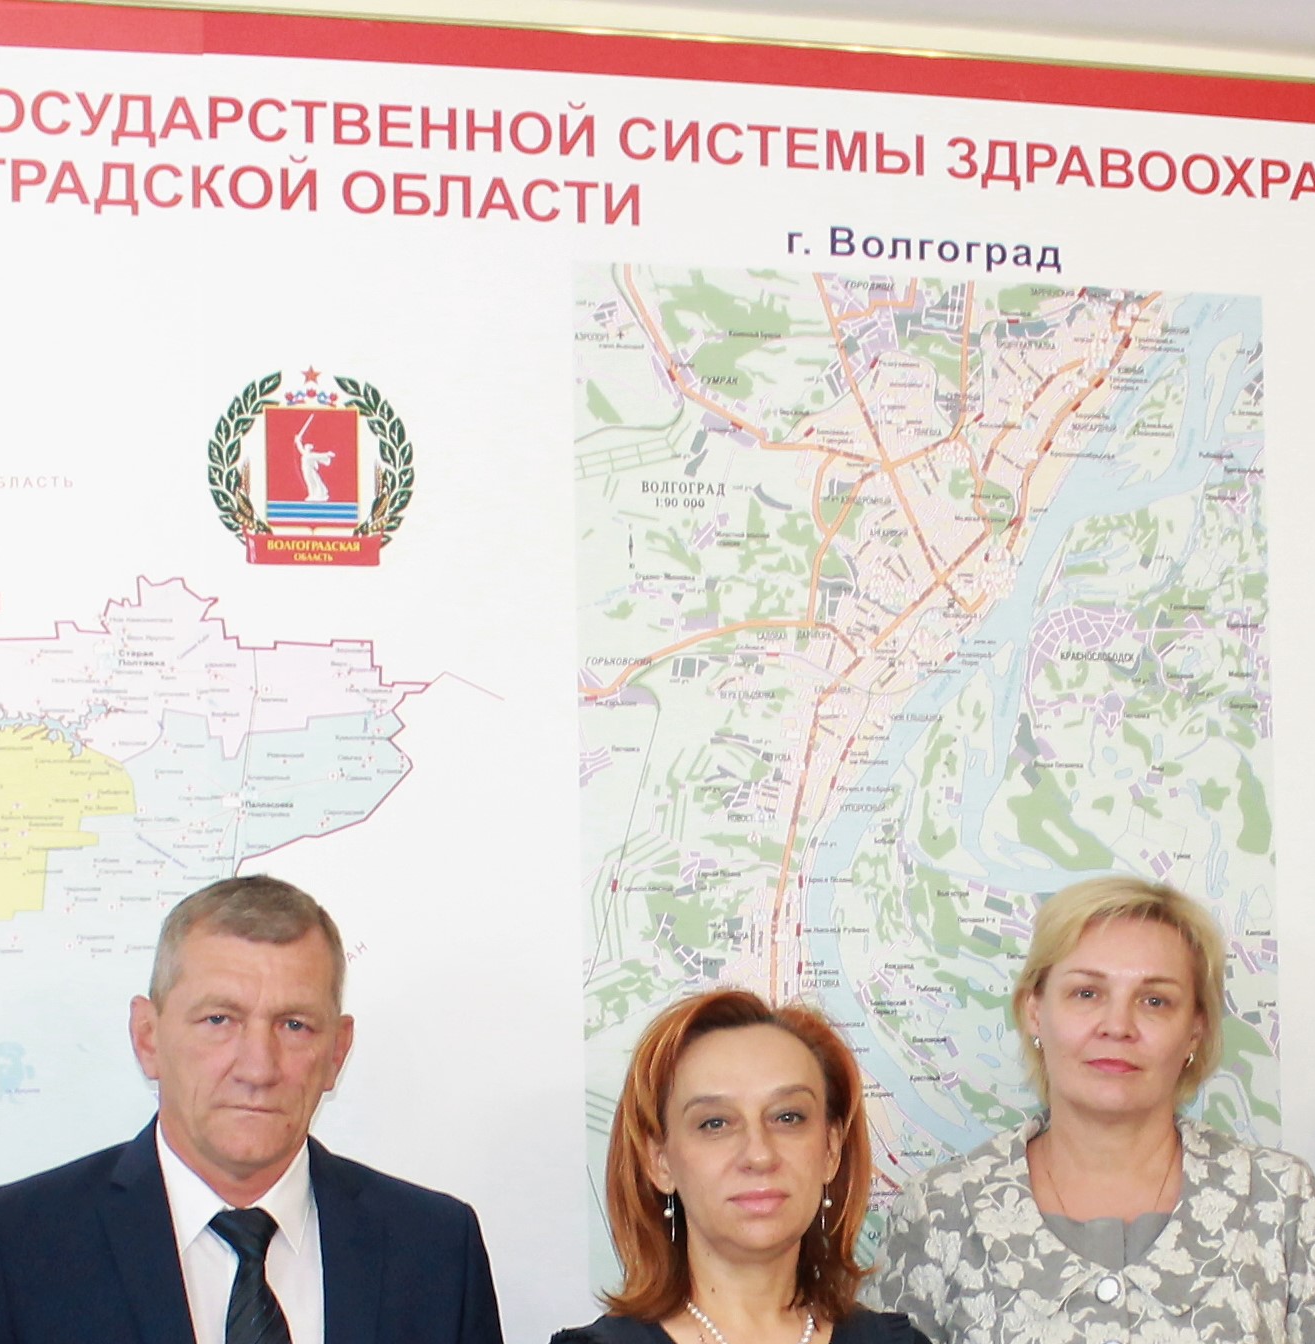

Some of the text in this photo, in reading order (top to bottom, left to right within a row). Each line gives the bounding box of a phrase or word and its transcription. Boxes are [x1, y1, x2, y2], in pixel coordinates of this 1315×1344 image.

[619, 117, 924, 176] СИСТЕМЫ
[342, 170, 640, 227] ОБЛАСТИ
[788, 225, 1062, 276] г. Волгоград
[641, 480, 726, 498] ВОЛГОГРАД
[655, 497, 706, 508] 1:90 000
[267, 539, 361, 552] ВОЛГОГРАДСКАЯ
[293, 553, 334, 562] ОБЛАСТЬ
[117, 649, 155, 659] Старая
[1060, 652, 1134, 663] КРАСНОСЛОБОДСК
